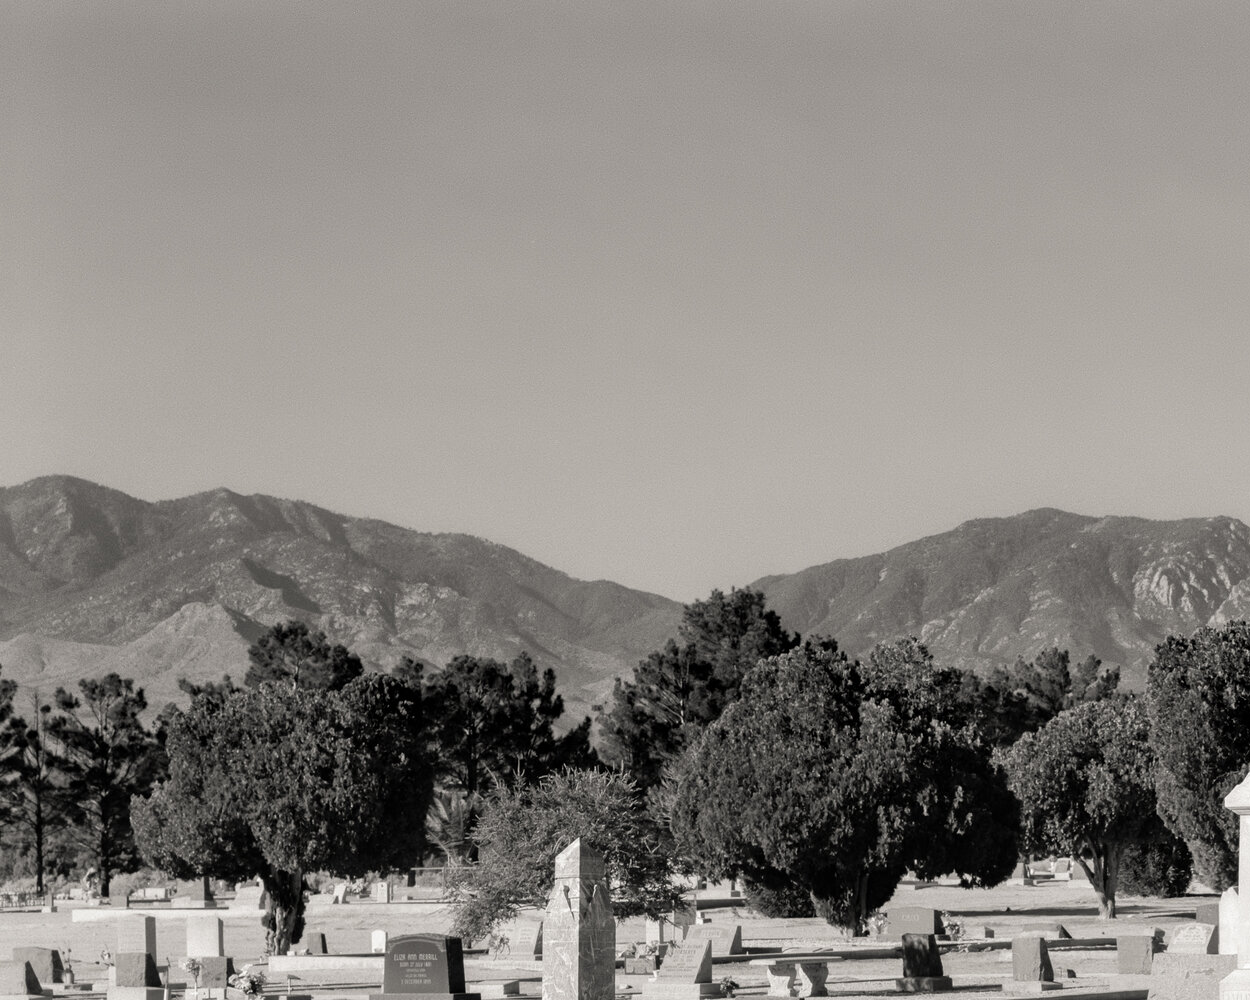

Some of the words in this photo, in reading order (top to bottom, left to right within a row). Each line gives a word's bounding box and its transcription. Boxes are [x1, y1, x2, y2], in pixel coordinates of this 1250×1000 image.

[393, 953, 406, 961] ELIZA
[407, 953, 417, 961] ANN
[418, 953, 438, 961] MERRILL
